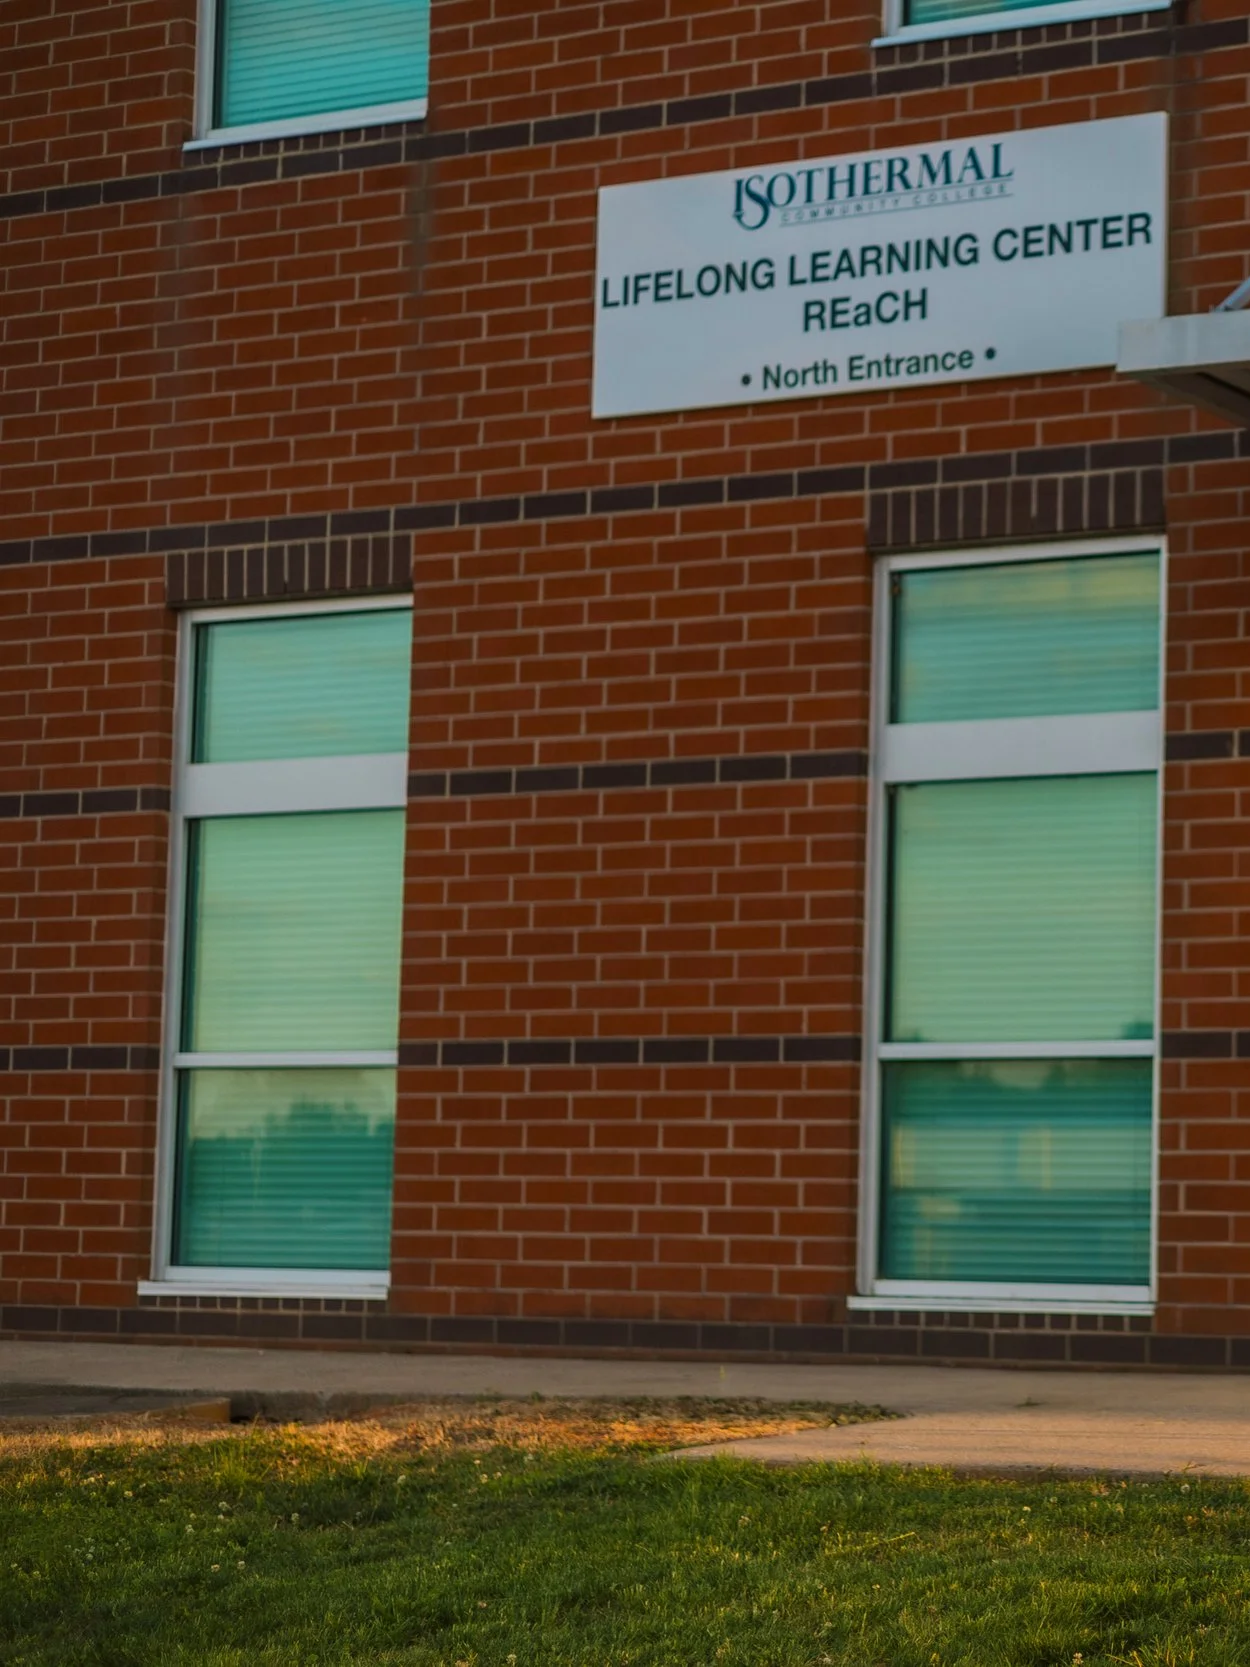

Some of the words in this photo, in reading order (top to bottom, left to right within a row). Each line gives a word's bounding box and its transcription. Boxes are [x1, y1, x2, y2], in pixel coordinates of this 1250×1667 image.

[733, 143, 1014, 231] ISOTHERMAL
[781, 198, 900, 222] COMMUNITY
[913, 183, 1007, 206] COLLEGE
[602, 257, 775, 308] LIFELONG
[788, 233, 979, 286] LEARNING
[994, 212, 1153, 262] CENTER
[803, 288, 928, 332] REaCH
[762, 360, 838, 391] North
[849, 349, 974, 381] Entrance
